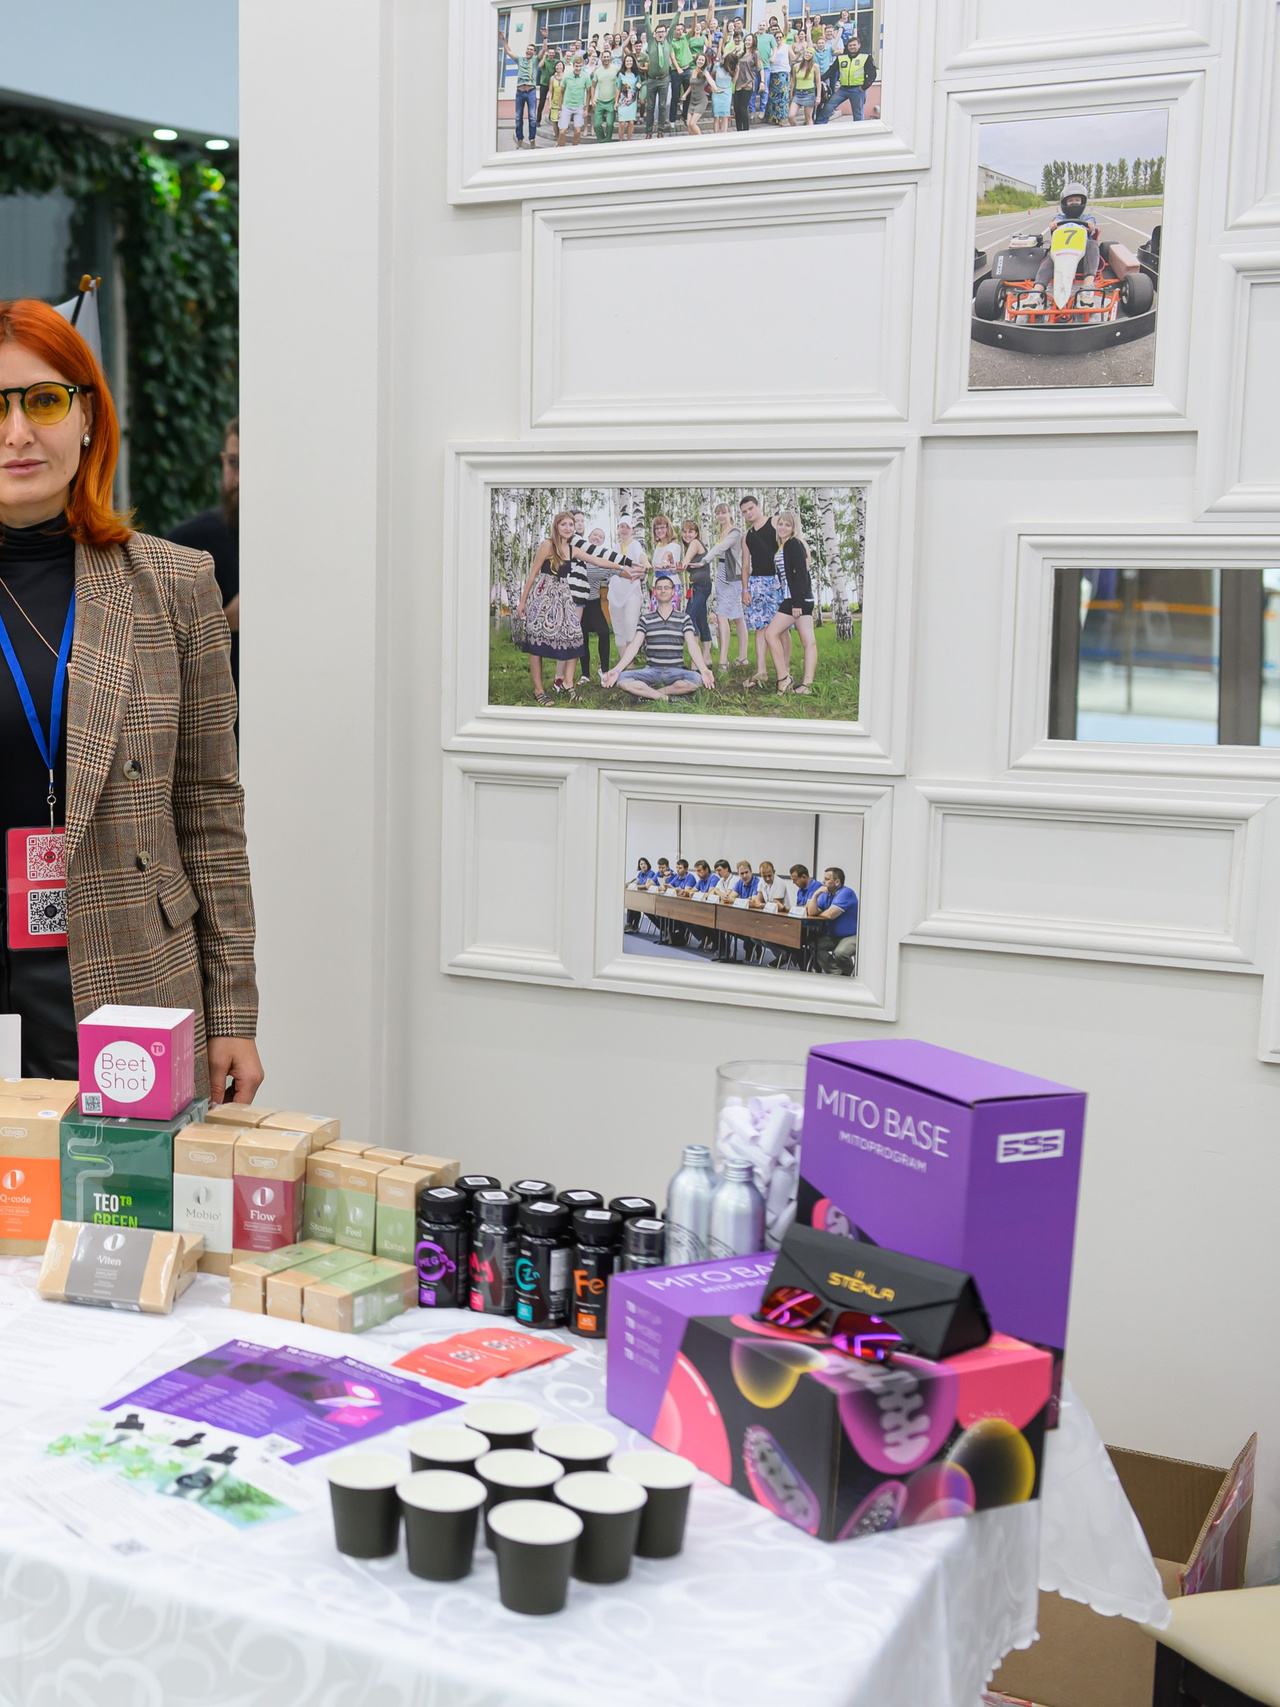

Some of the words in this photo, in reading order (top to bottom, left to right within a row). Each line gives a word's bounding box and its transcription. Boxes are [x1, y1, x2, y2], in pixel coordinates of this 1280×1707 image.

[1064, 230, 1077, 245] 7
[101, 1053, 147, 1072] Beet
[101, 1072, 148, 1091] Shot
[817, 1083, 880, 1129] MITO
[883, 1107, 951, 1158] BASE
[838, 1130, 927, 1173] MITOPROGRAM
[93, 1193, 119, 1212] TEO
[120, 1195, 132, 1207] T8
[93, 1212, 138, 1228] GREEN
[250, 1209, 276, 1222] Flow
[310, 1221, 333, 1234] Stone
[345, 1226, 362, 1238] Feel
[573, 1269, 605, 1297] Fe
[646, 1271, 732, 1291] MITO
